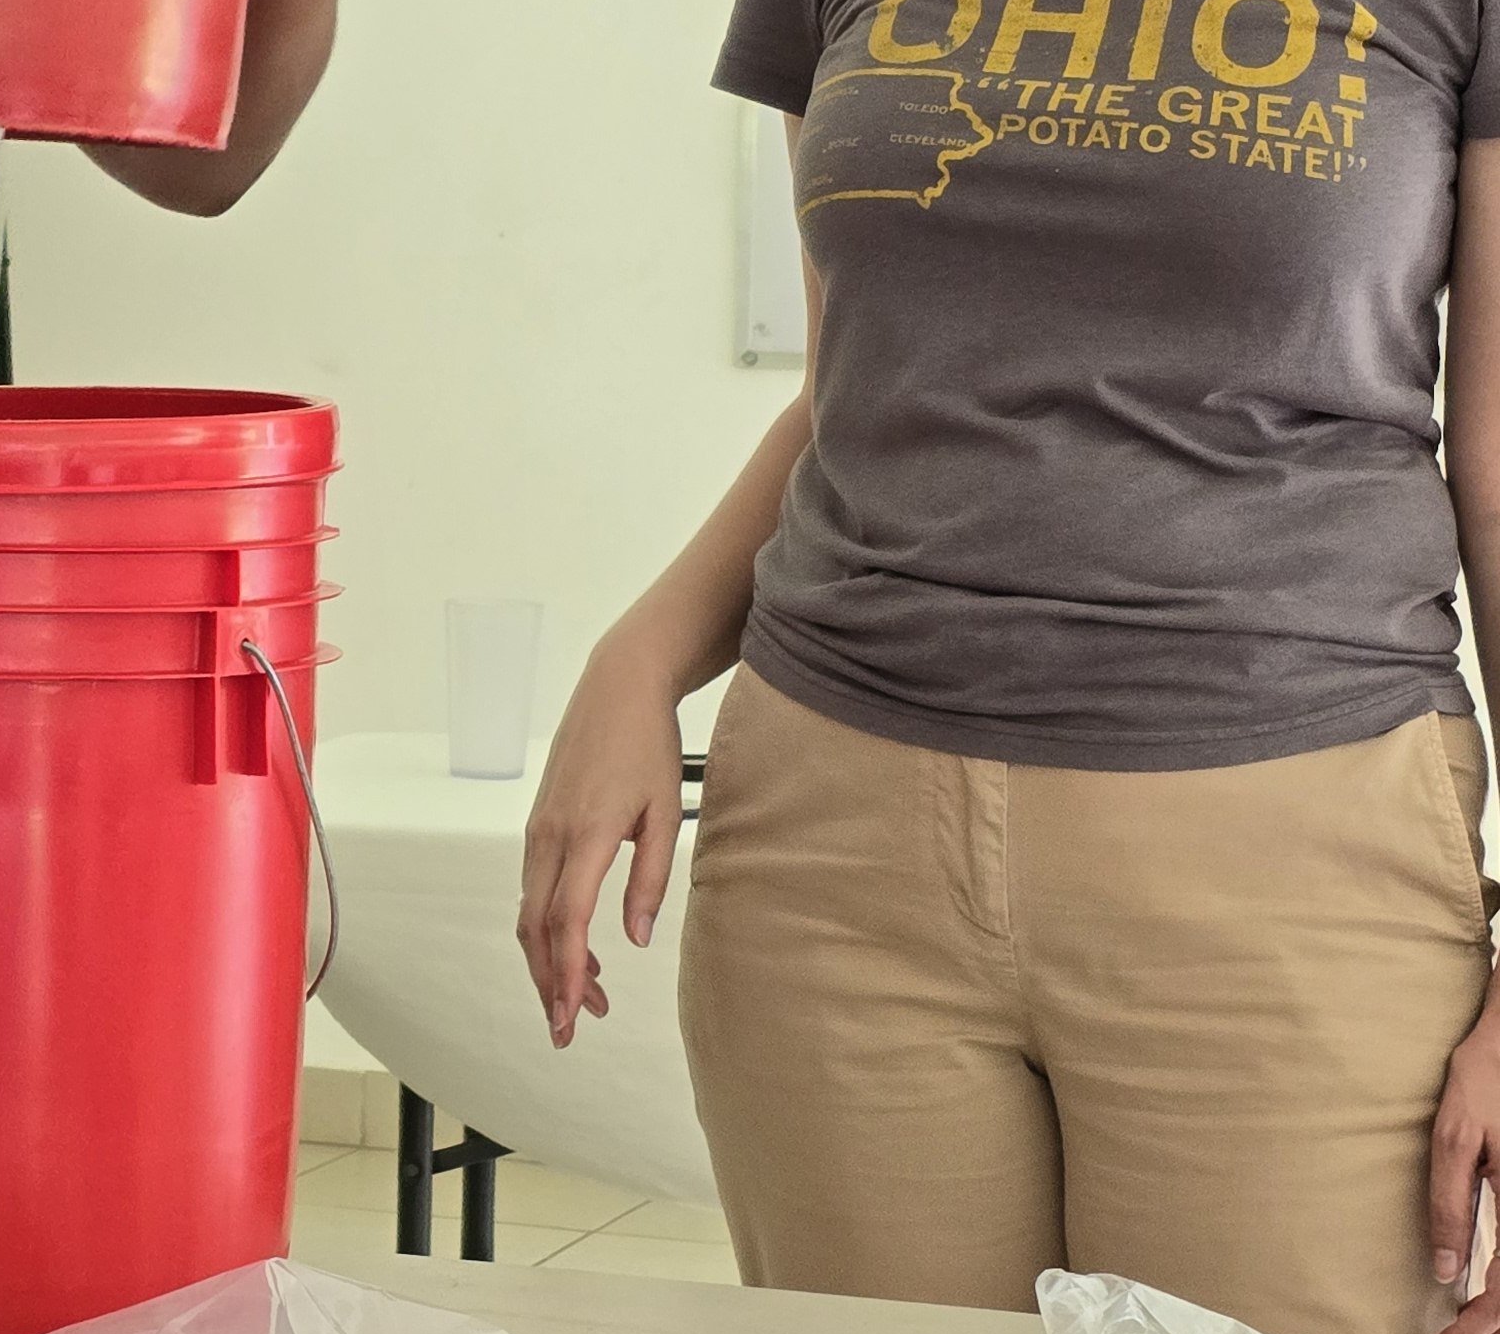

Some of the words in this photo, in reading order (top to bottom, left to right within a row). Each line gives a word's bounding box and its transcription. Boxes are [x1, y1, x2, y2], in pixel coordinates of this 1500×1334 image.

[900, 101, 949, 115] TOLEDO
[1157, 84, 1365, 149] GREAT
[889, 134, 967, 148] CLEVELAND
[996, 113, 1172, 154] POTATO
